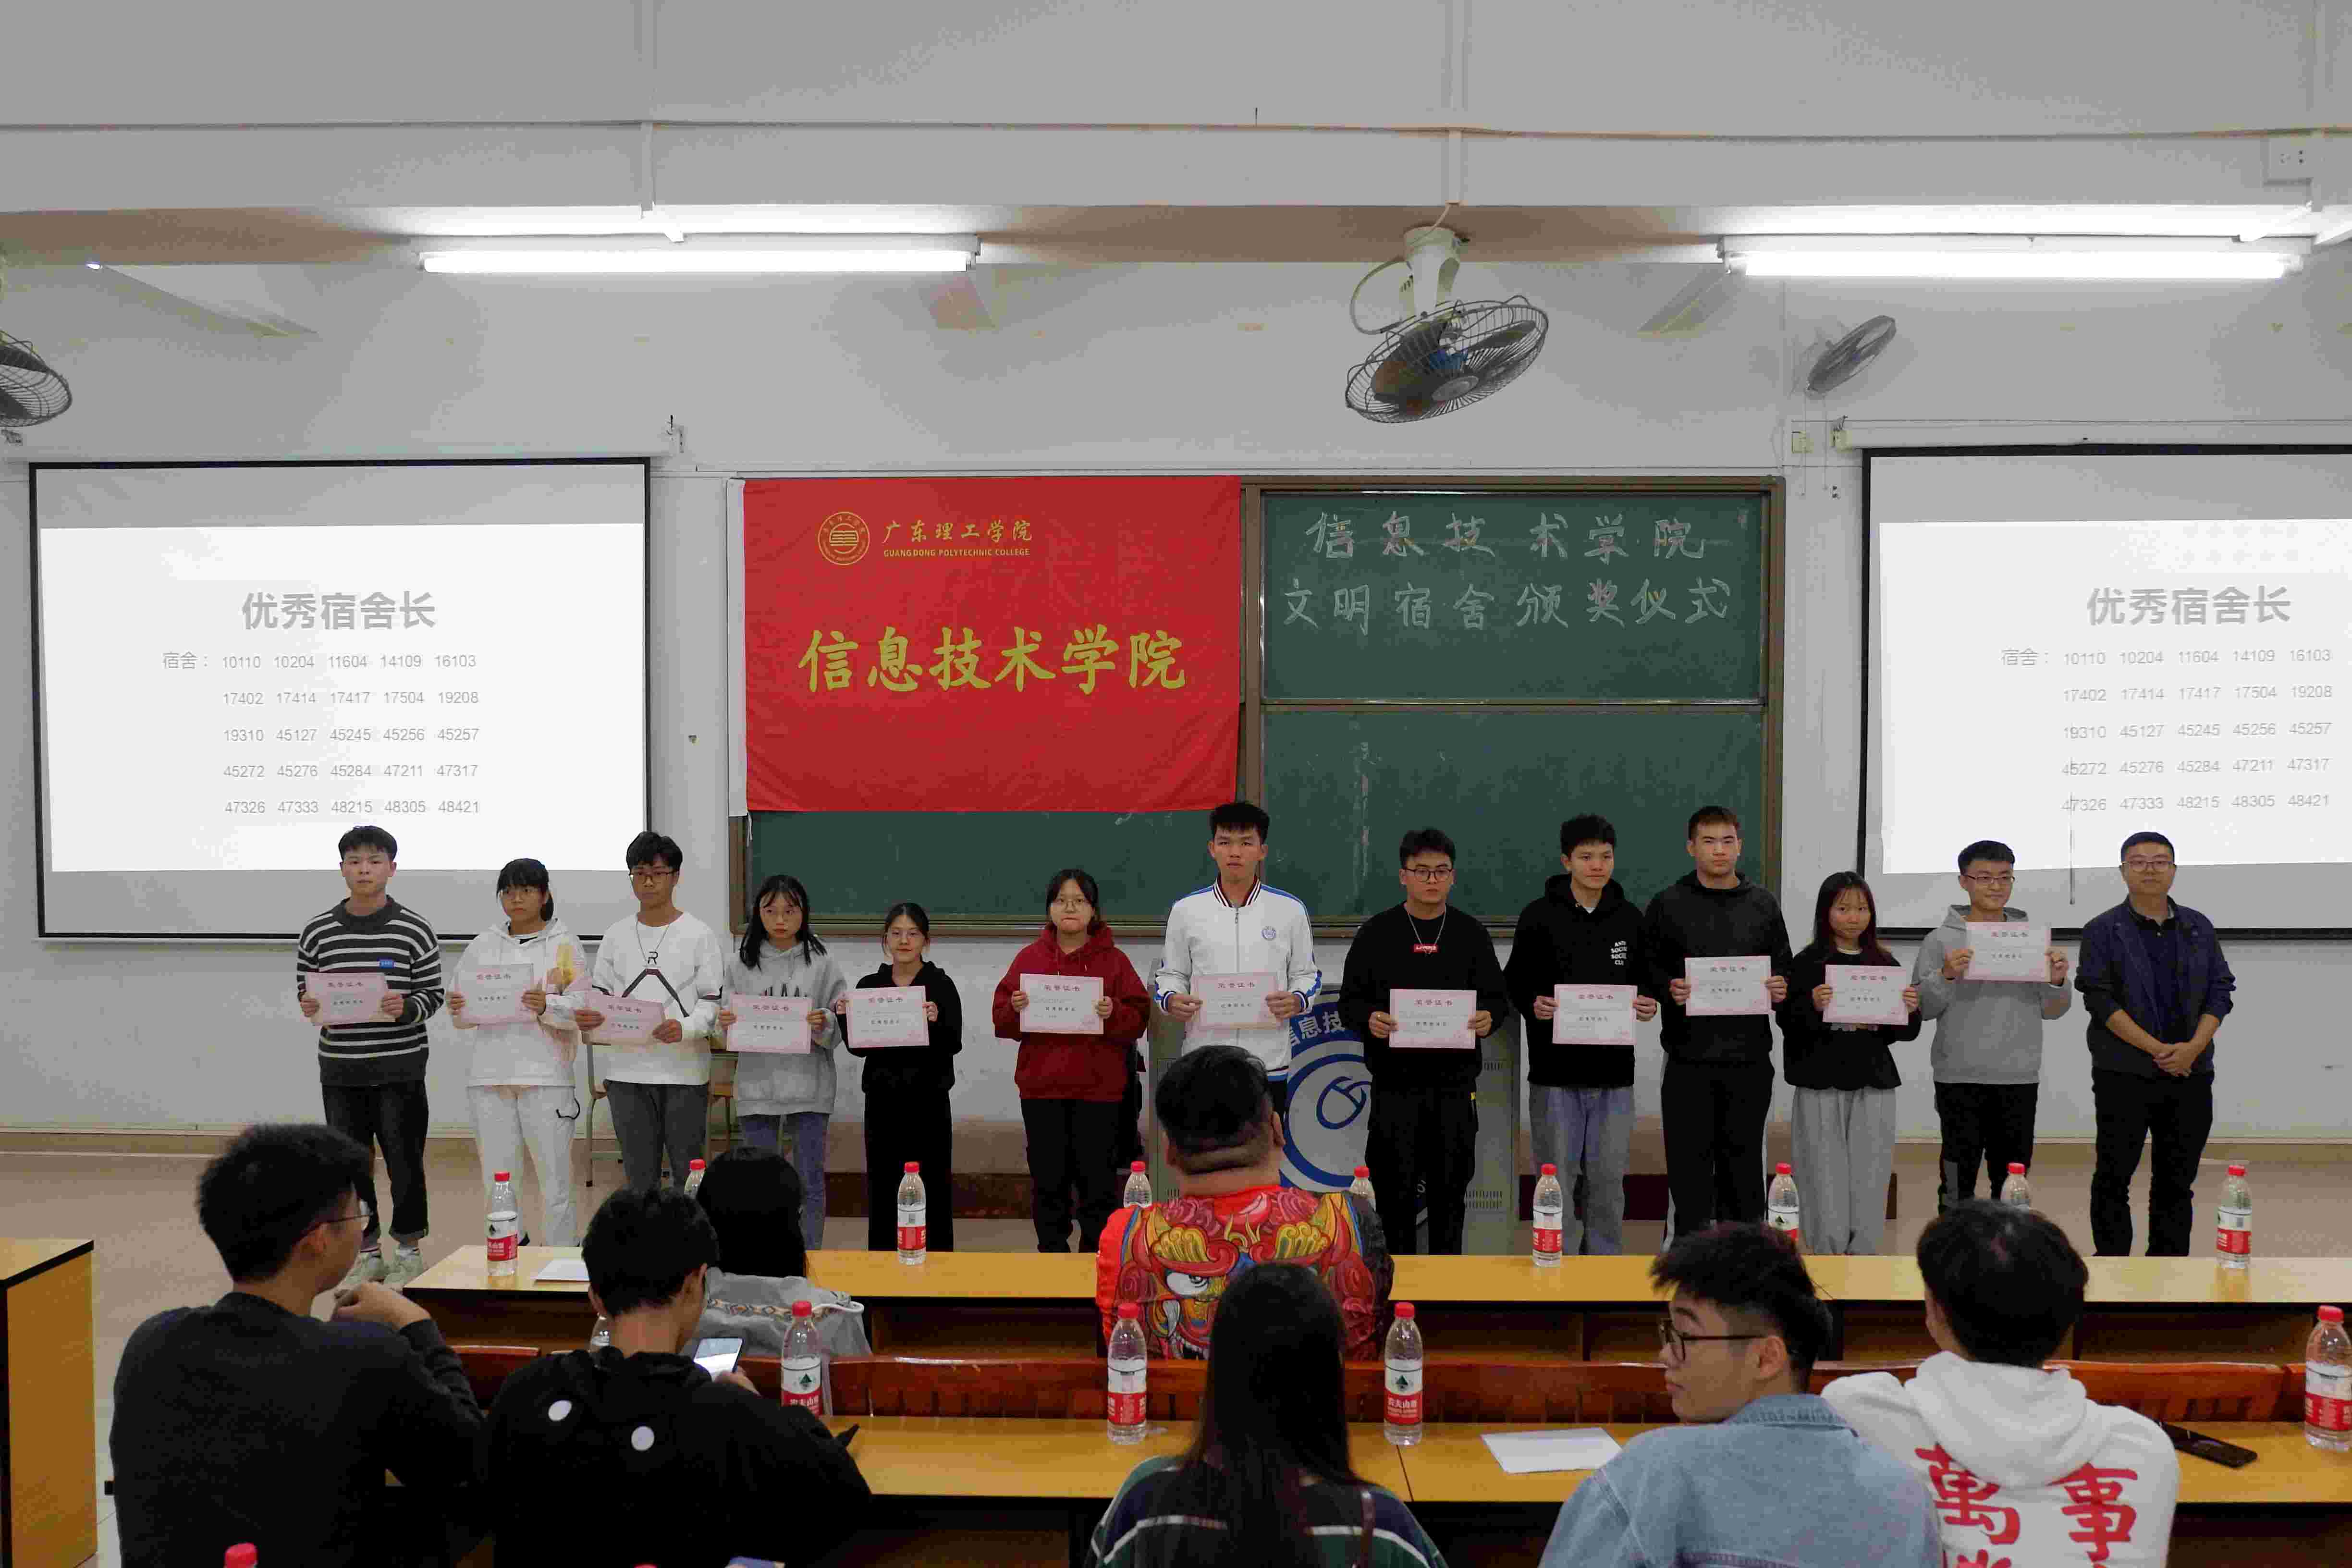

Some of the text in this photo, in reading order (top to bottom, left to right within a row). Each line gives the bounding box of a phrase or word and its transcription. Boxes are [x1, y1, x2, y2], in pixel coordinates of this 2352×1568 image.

[882, 519, 1032, 544] 广东理工学院
[1305, 511, 1706, 564] 信息技术学院
[939, 549, 992, 557] POLYTECHNIC
[995, 548, 1030, 557] COLLEGE
[242, 591, 436, 630] 优秀宿舍长
[1284, 577, 1730, 635] 文明宿舍颁奖仪式
[2087, 586, 2291, 625] 优秀宿舍长
[162, 651, 477, 669] 宿舍： 10110 10204 11604 14109 16103
[798, 624, 1186, 696] 信息技术学院
[2001, 648, 2331, 666] 宿舍： 10110 10204 11604 14109 16103
[223, 692, 479, 705] 17402 17414 17417 17504 19208
[2064, 686, 2332, 701] 17402 17414 17417 17504 19208
[224, 728, 479, 741] 19310 45127 45245 45256 45257
[2064, 723, 2333, 739] 19310 45127 45245 45256 45257
[223, 765, 478, 777] 45272 45276 45284 47211 47317
[2062, 759, 2329, 775] 45272 45276 45284 47211 47317
[225, 800, 479, 813] 47326 47333 48215 48305 48421
[2061, 795, 2329, 811] 47326 47333 48215 48305 48421
